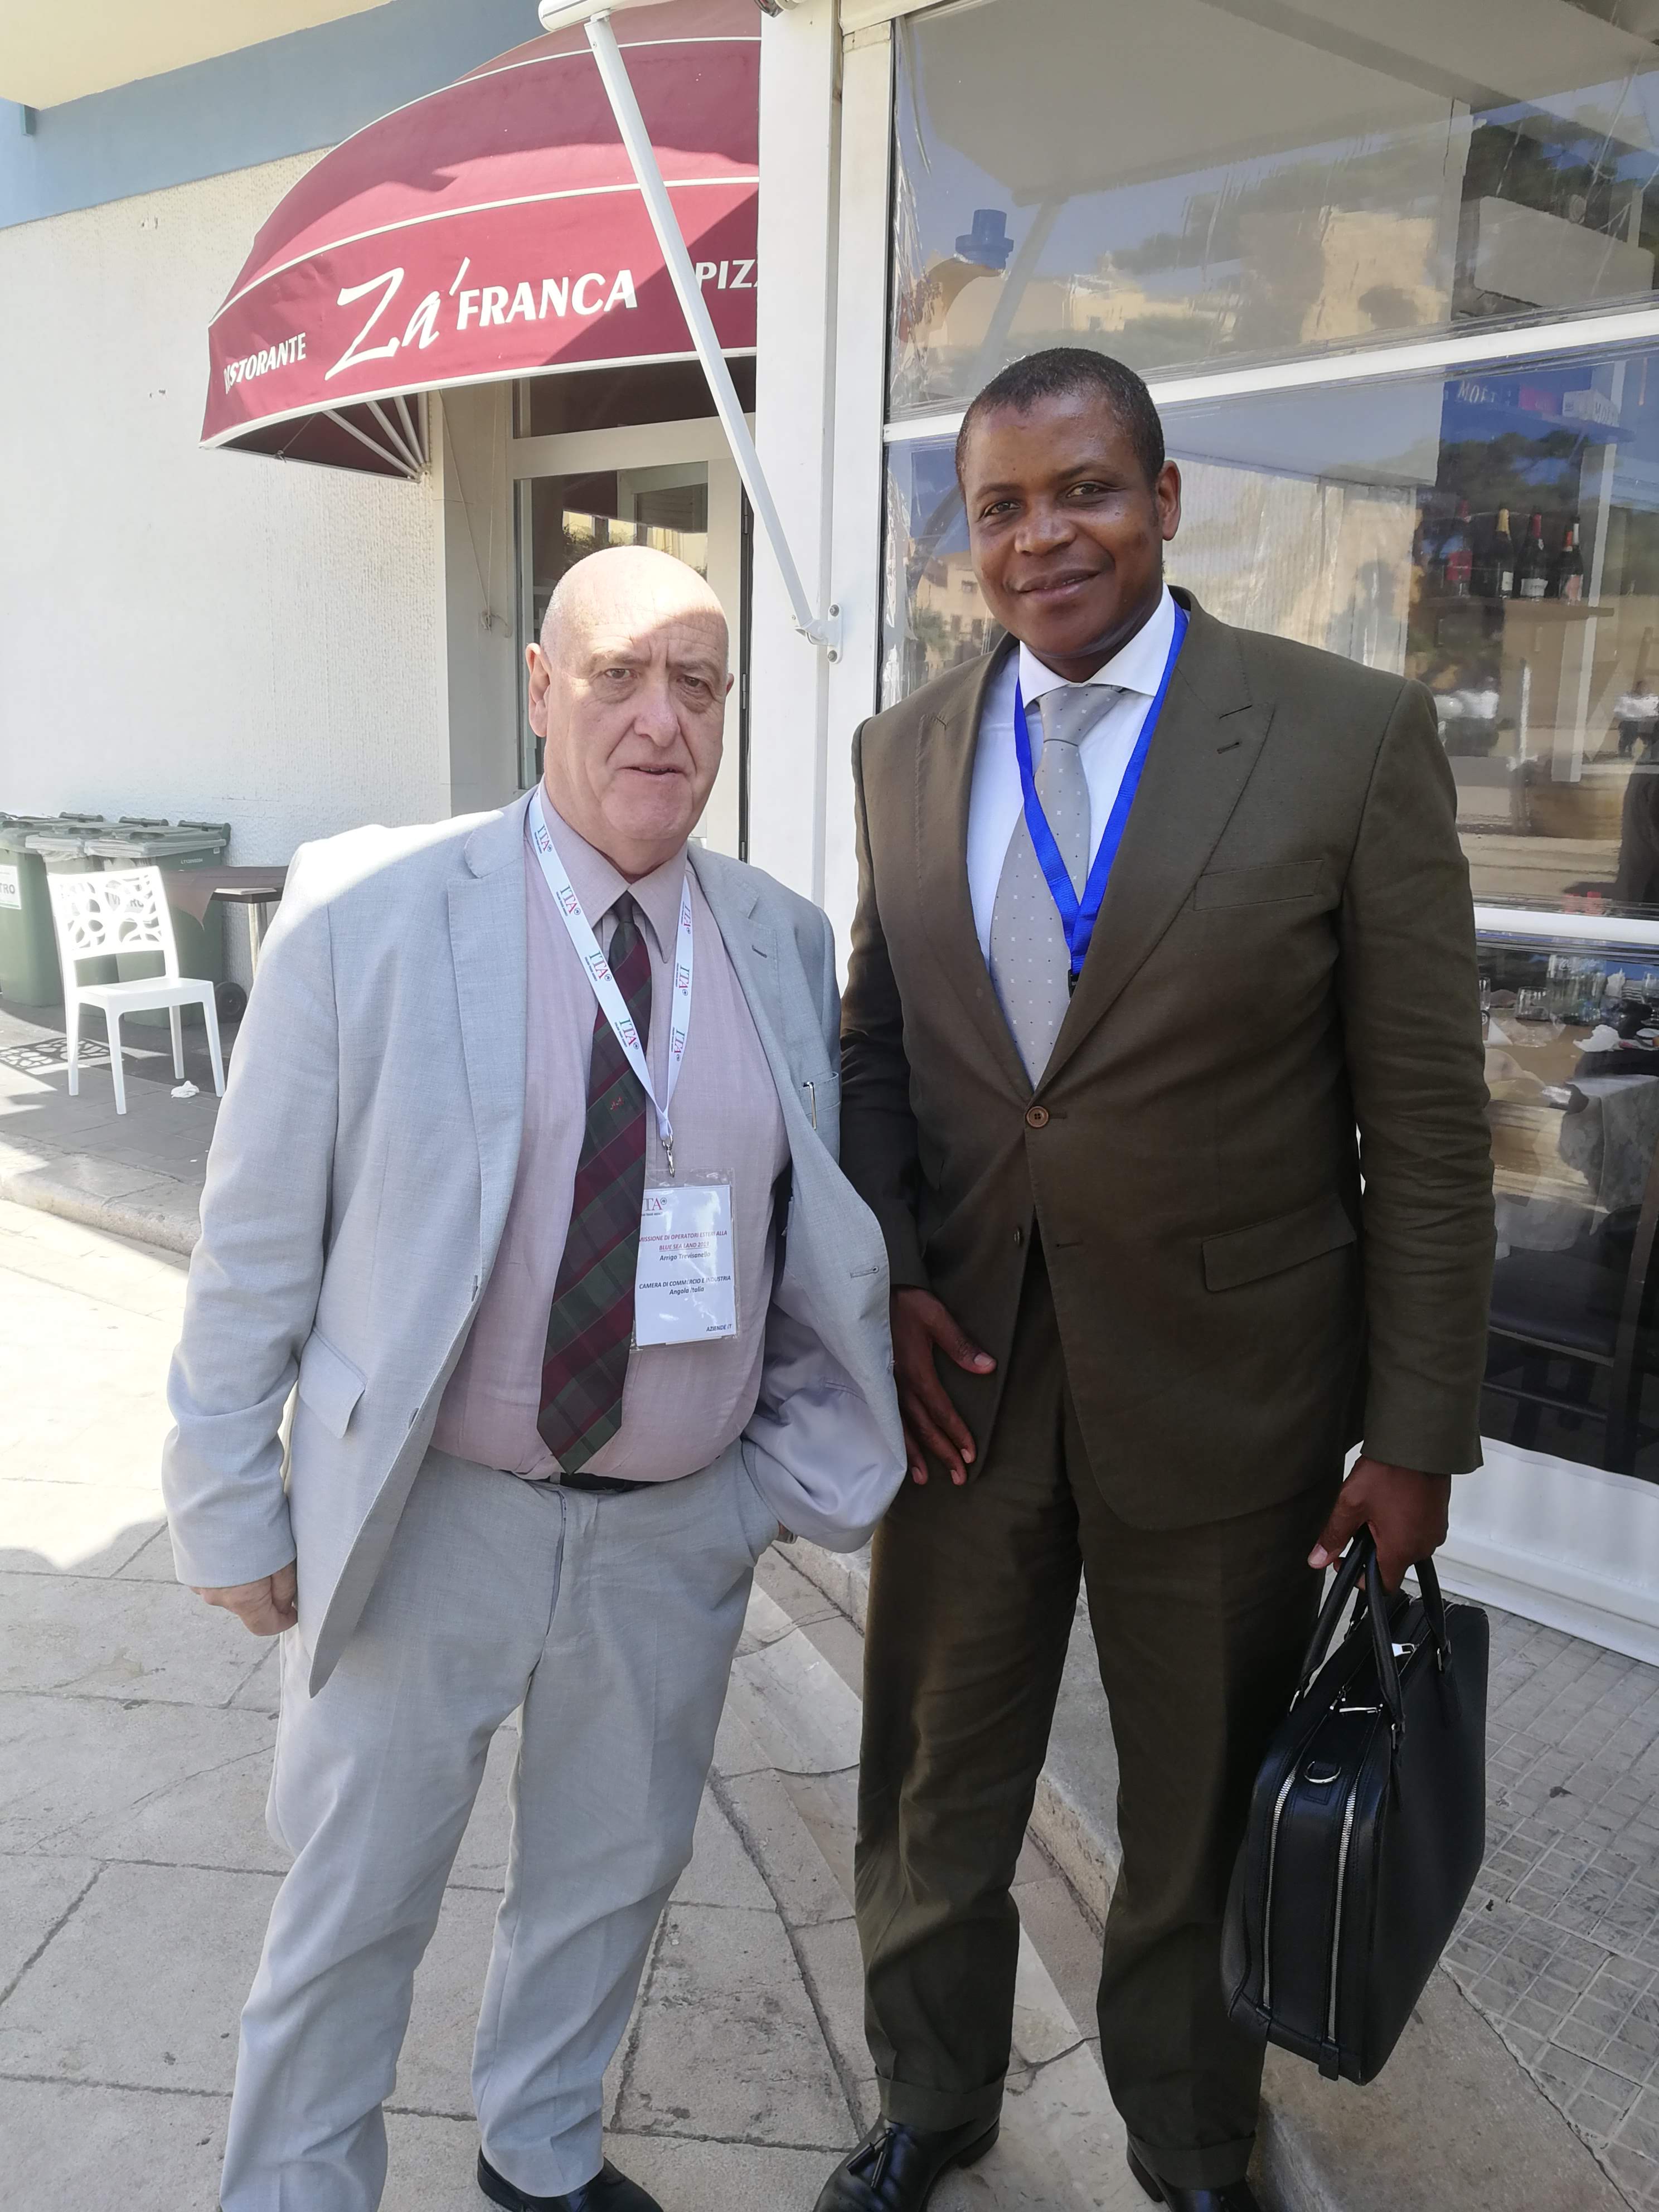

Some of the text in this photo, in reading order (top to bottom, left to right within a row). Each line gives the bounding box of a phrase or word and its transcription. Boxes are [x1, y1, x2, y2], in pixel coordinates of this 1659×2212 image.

[456, 269, 638, 330] FRANCA
[695, 259, 758, 290] PIZ
[560, 885, 578, 915] ITA
[589, 950, 609, 979] ITA
[678, 964, 690, 988] ITA
[619, 1017, 637, 1047] ITA
[669, 1278, 701, 1287] COMMERCIO
